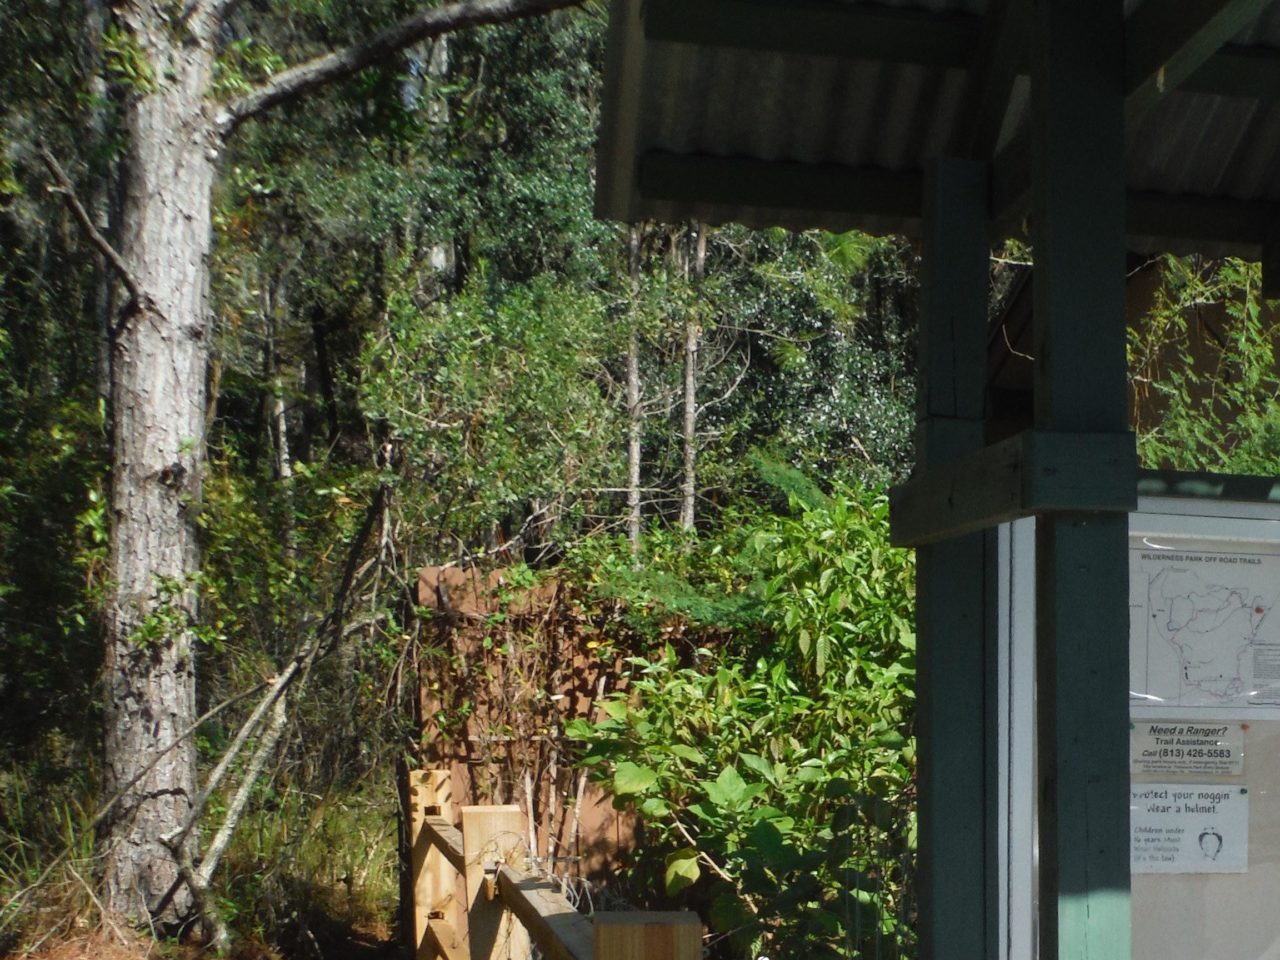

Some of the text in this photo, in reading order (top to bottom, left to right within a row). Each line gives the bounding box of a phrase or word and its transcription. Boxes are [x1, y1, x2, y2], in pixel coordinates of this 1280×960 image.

[1141, 553, 1262, 566] WILDERNESS PARK OFF ROAD TRAILS
[1150, 725, 1228, 738] Need a Ranger?
[1155, 737, 1220, 747] Trail Assistance
[1142, 748, 1231, 759] Call (813) 426-5583
[1172, 791, 1194, 803] your
[1198, 791, 1230, 804] noggin
